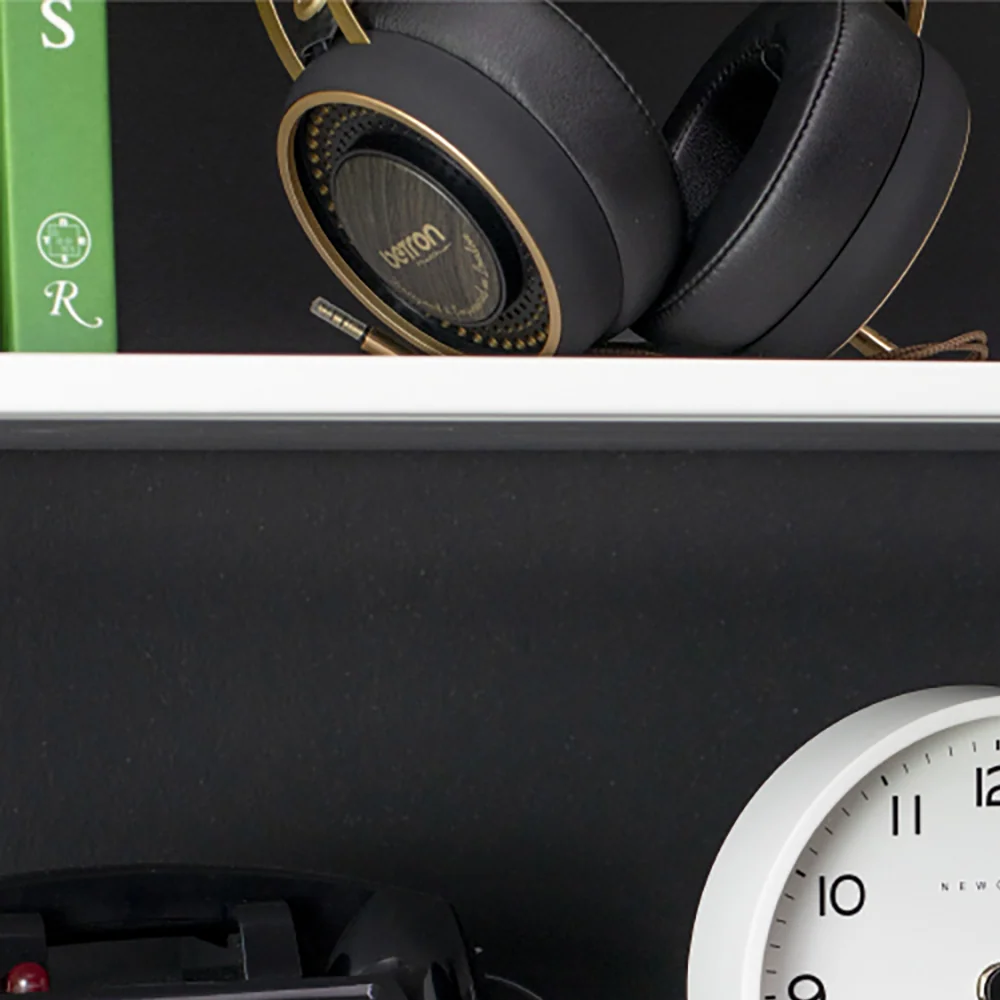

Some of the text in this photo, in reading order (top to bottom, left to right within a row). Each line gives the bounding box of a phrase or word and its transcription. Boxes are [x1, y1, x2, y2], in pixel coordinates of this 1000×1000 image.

[40, 0, 76, 49] S
[43, 280, 104, 329] R
[891, 795, 921, 837] 11
[818, 874, 866, 917] 10
